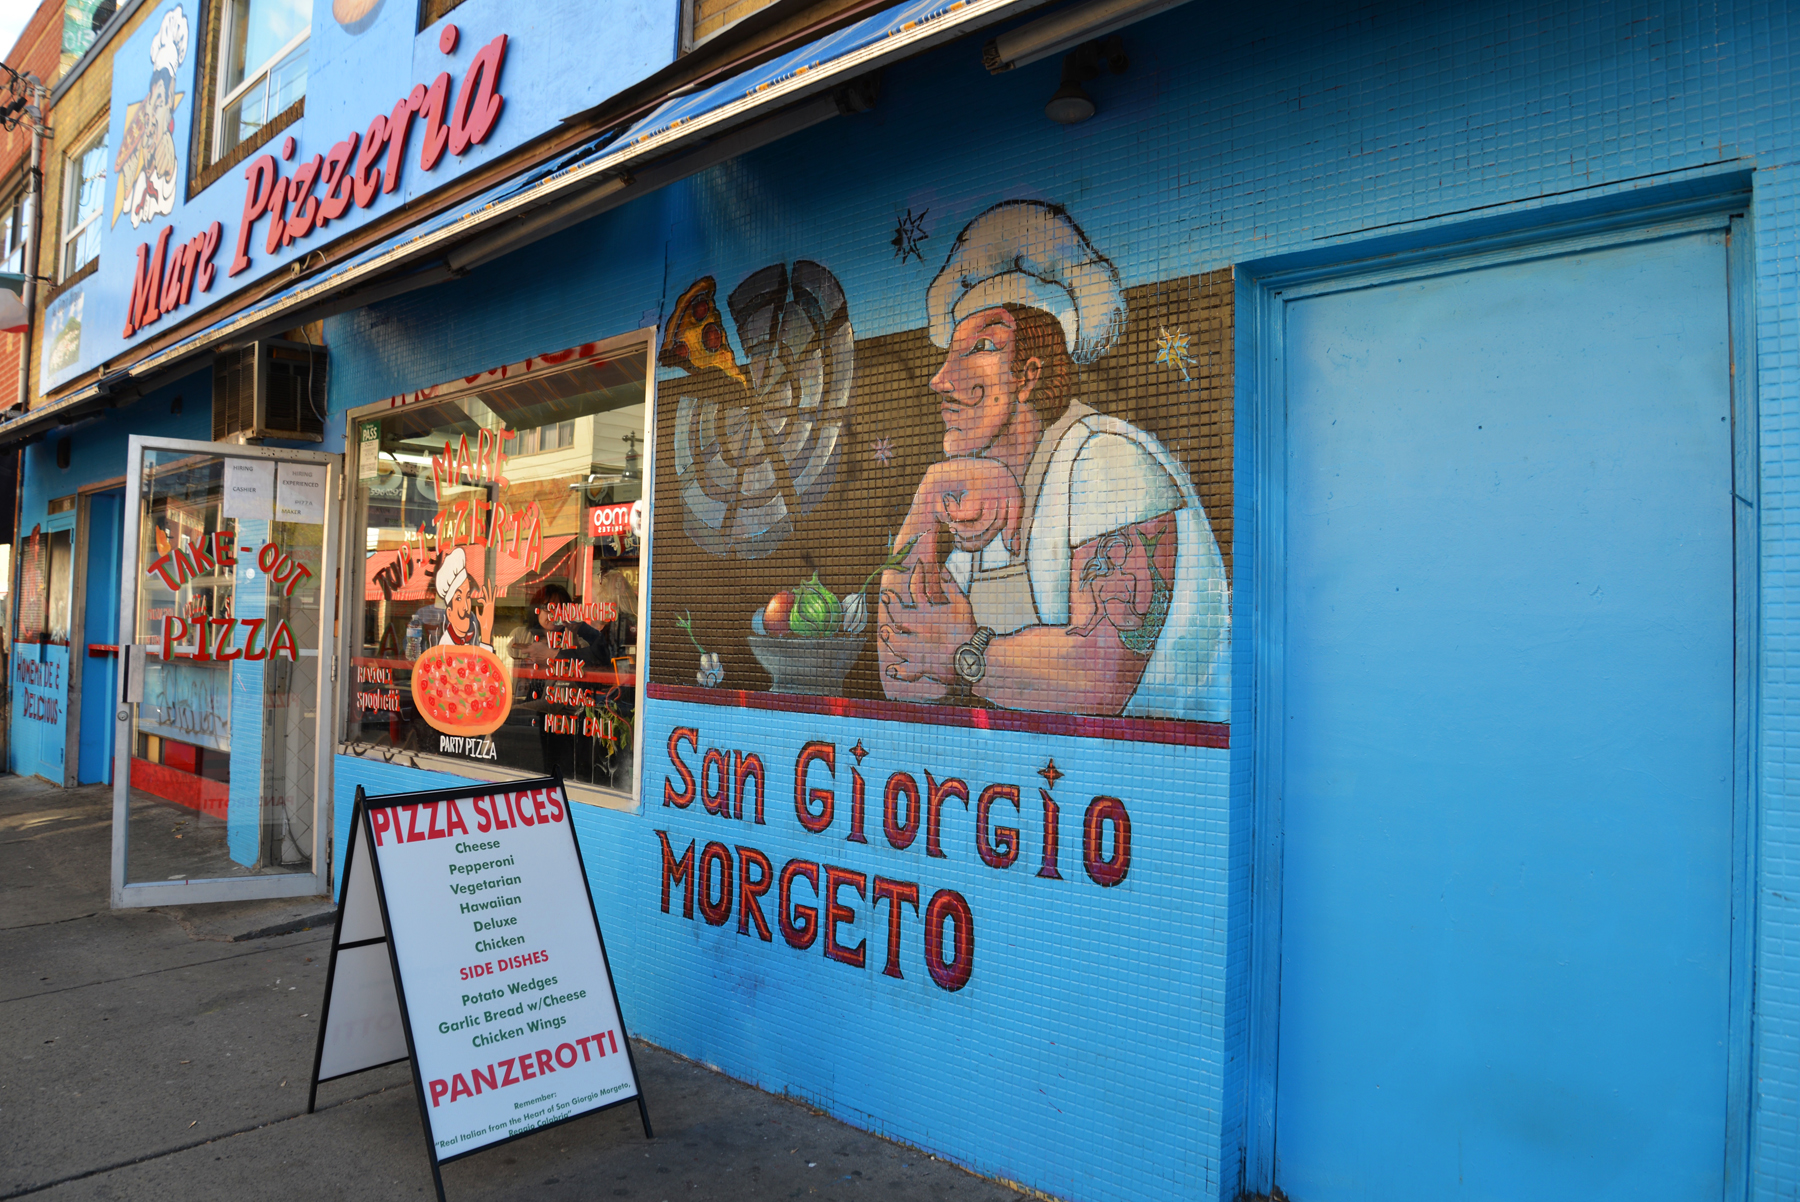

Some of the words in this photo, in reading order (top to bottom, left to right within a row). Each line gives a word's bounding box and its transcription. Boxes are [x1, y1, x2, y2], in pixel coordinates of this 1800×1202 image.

[122, 221, 221, 340] Mare
[229, 23, 508, 278] Pizzeria
[362, 427, 378, 441] PASS
[432, 427, 517, 503] MARE
[282, 480, 319, 488] EXPERIENCED
[398, 498, 543, 587] PIZZERIA
[547, 602, 618, 622] SANDWICHES
[159, 614, 300, 662] PIZZA
[546, 630, 577, 649] VEAL
[546, 657, 585, 679] STEAK
[544, 713, 578, 735] MEAT
[583, 716, 617, 741] BALL
[440, 735, 465, 754] PARTY
[466, 737, 497, 760] PIZZA
[663, 726, 766, 825] San
[371, 799, 469, 847] PIZZA
[472, 786, 565, 833] SLICES
[455, 839, 501, 854] Cheese
[448, 854, 515, 875] Pepperoni
[449, 874, 522, 895] Vegetarian
[459, 894, 522, 914] Hawaiian
[653, 828, 975, 993] MORGETO
[473, 916, 518, 932] Deluxe
[474, 933, 525, 953] Chicken
[459, 962, 494, 980] SIDE
[497, 949, 549, 972] DISHES
[461, 988, 505, 1006] Potato
[507, 974, 558, 995] Wedges
[438, 1014, 481, 1034] Garlic
[484, 1002, 524, 1023] Bread
[527, 988, 587, 1011] w/Cheese
[472, 1027, 524, 1048] Chicken
[526, 1014, 567, 1033] Wings
[428, 1029, 618, 1108] PANZEROTTI
[460, 1129, 487, 1142] Italian
[488, 1121, 507, 1133] from
[509, 1116, 522, 1126] the
[523, 1108, 545, 1121] Heart
[547, 1104, 555, 1114] of
[555, 1101, 570, 1111] San
[572, 1092, 599, 1106] Giorgio
[599, 1083, 631, 1097] Morgeto,
[513, 1091, 557, 1111] Remember:
